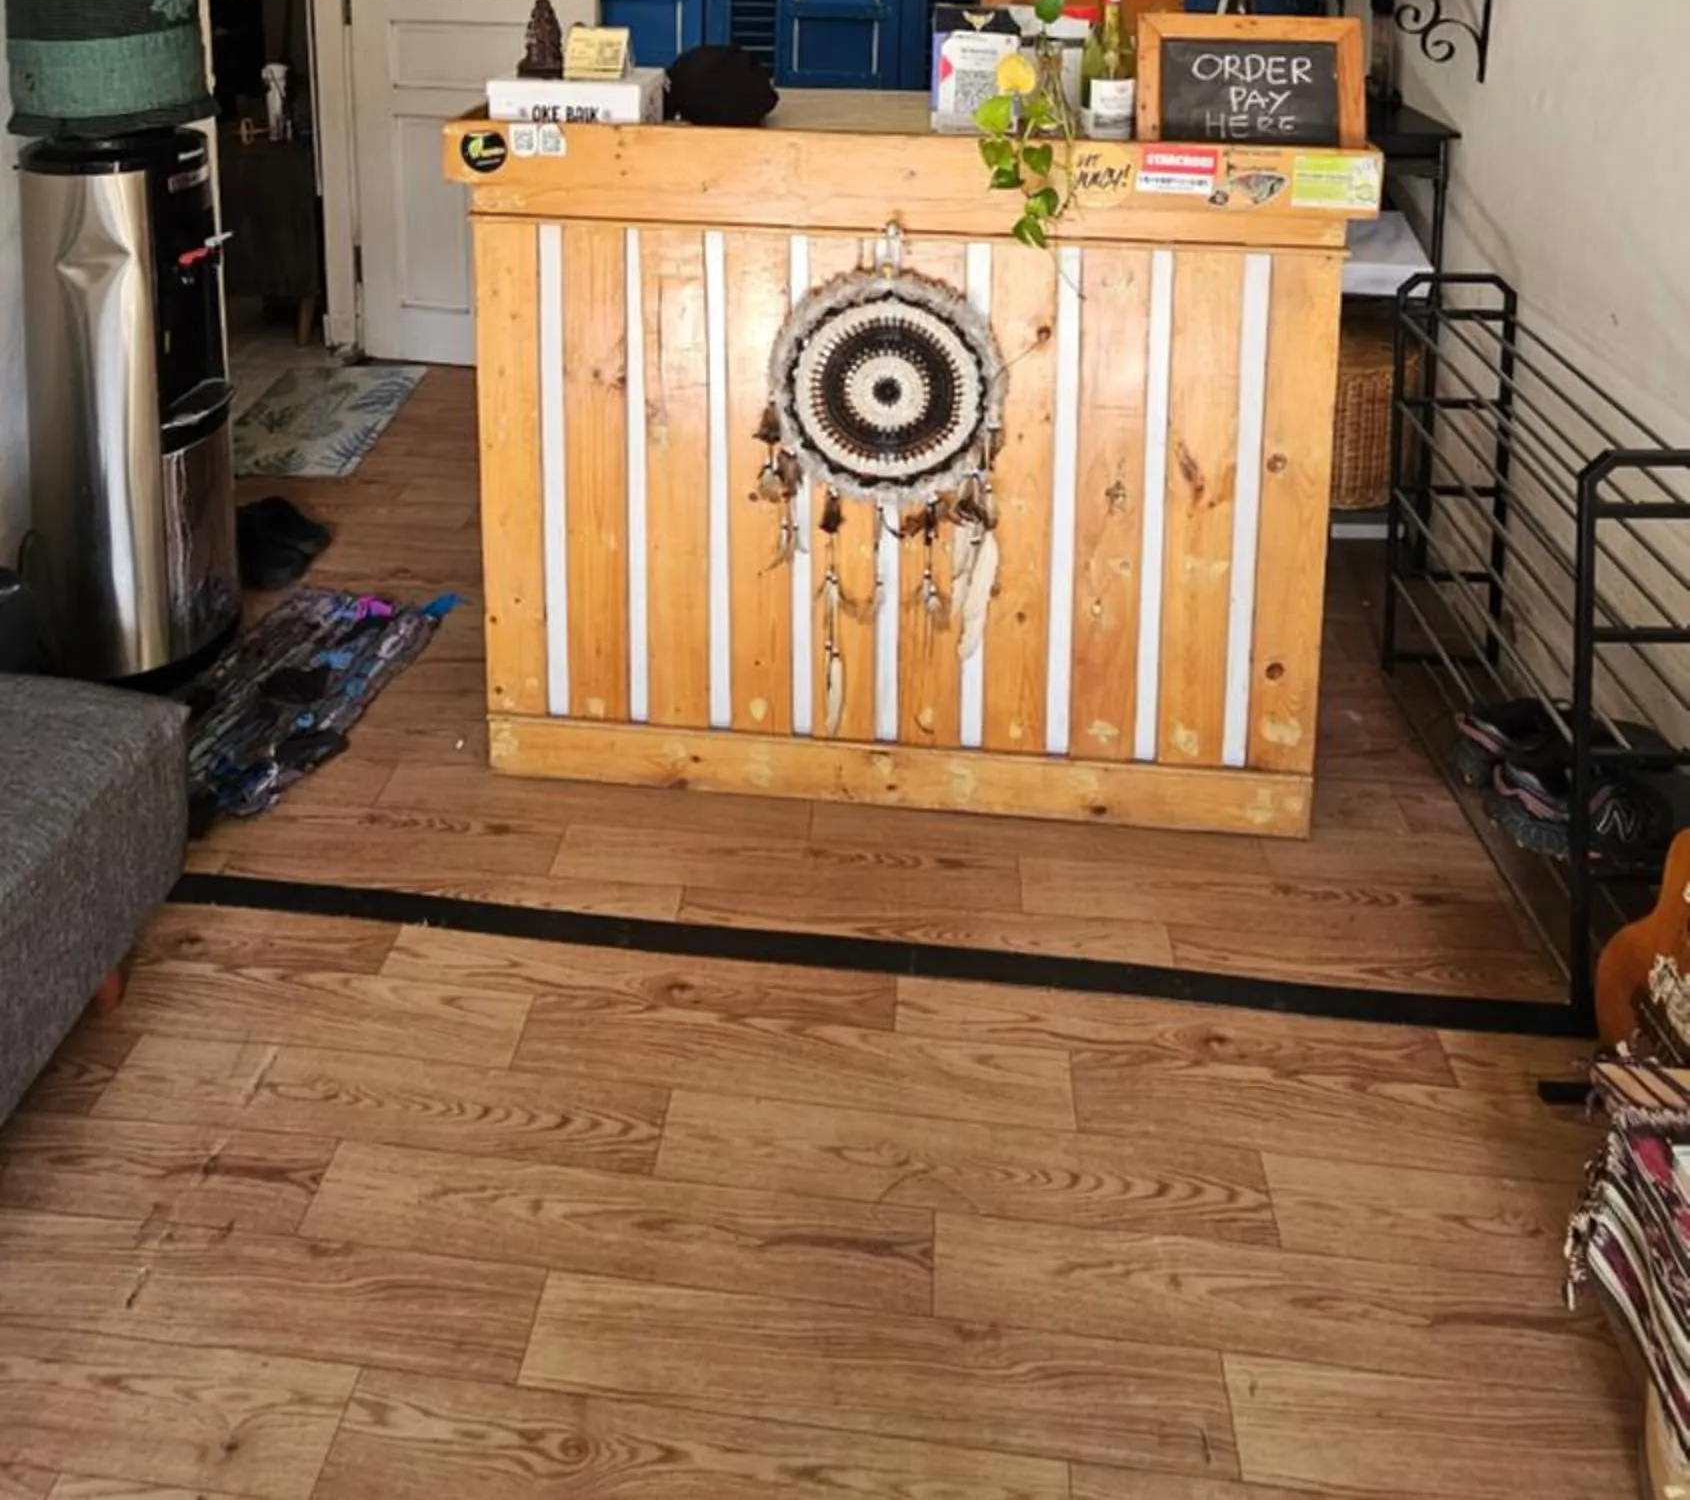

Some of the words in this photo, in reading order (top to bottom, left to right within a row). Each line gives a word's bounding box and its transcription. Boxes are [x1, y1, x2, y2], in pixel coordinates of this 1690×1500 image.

[1192, 53, 1312, 85] ORDER
[1229, 86, 1292, 114] PAY
[1205, 109, 1297, 138] HERE
